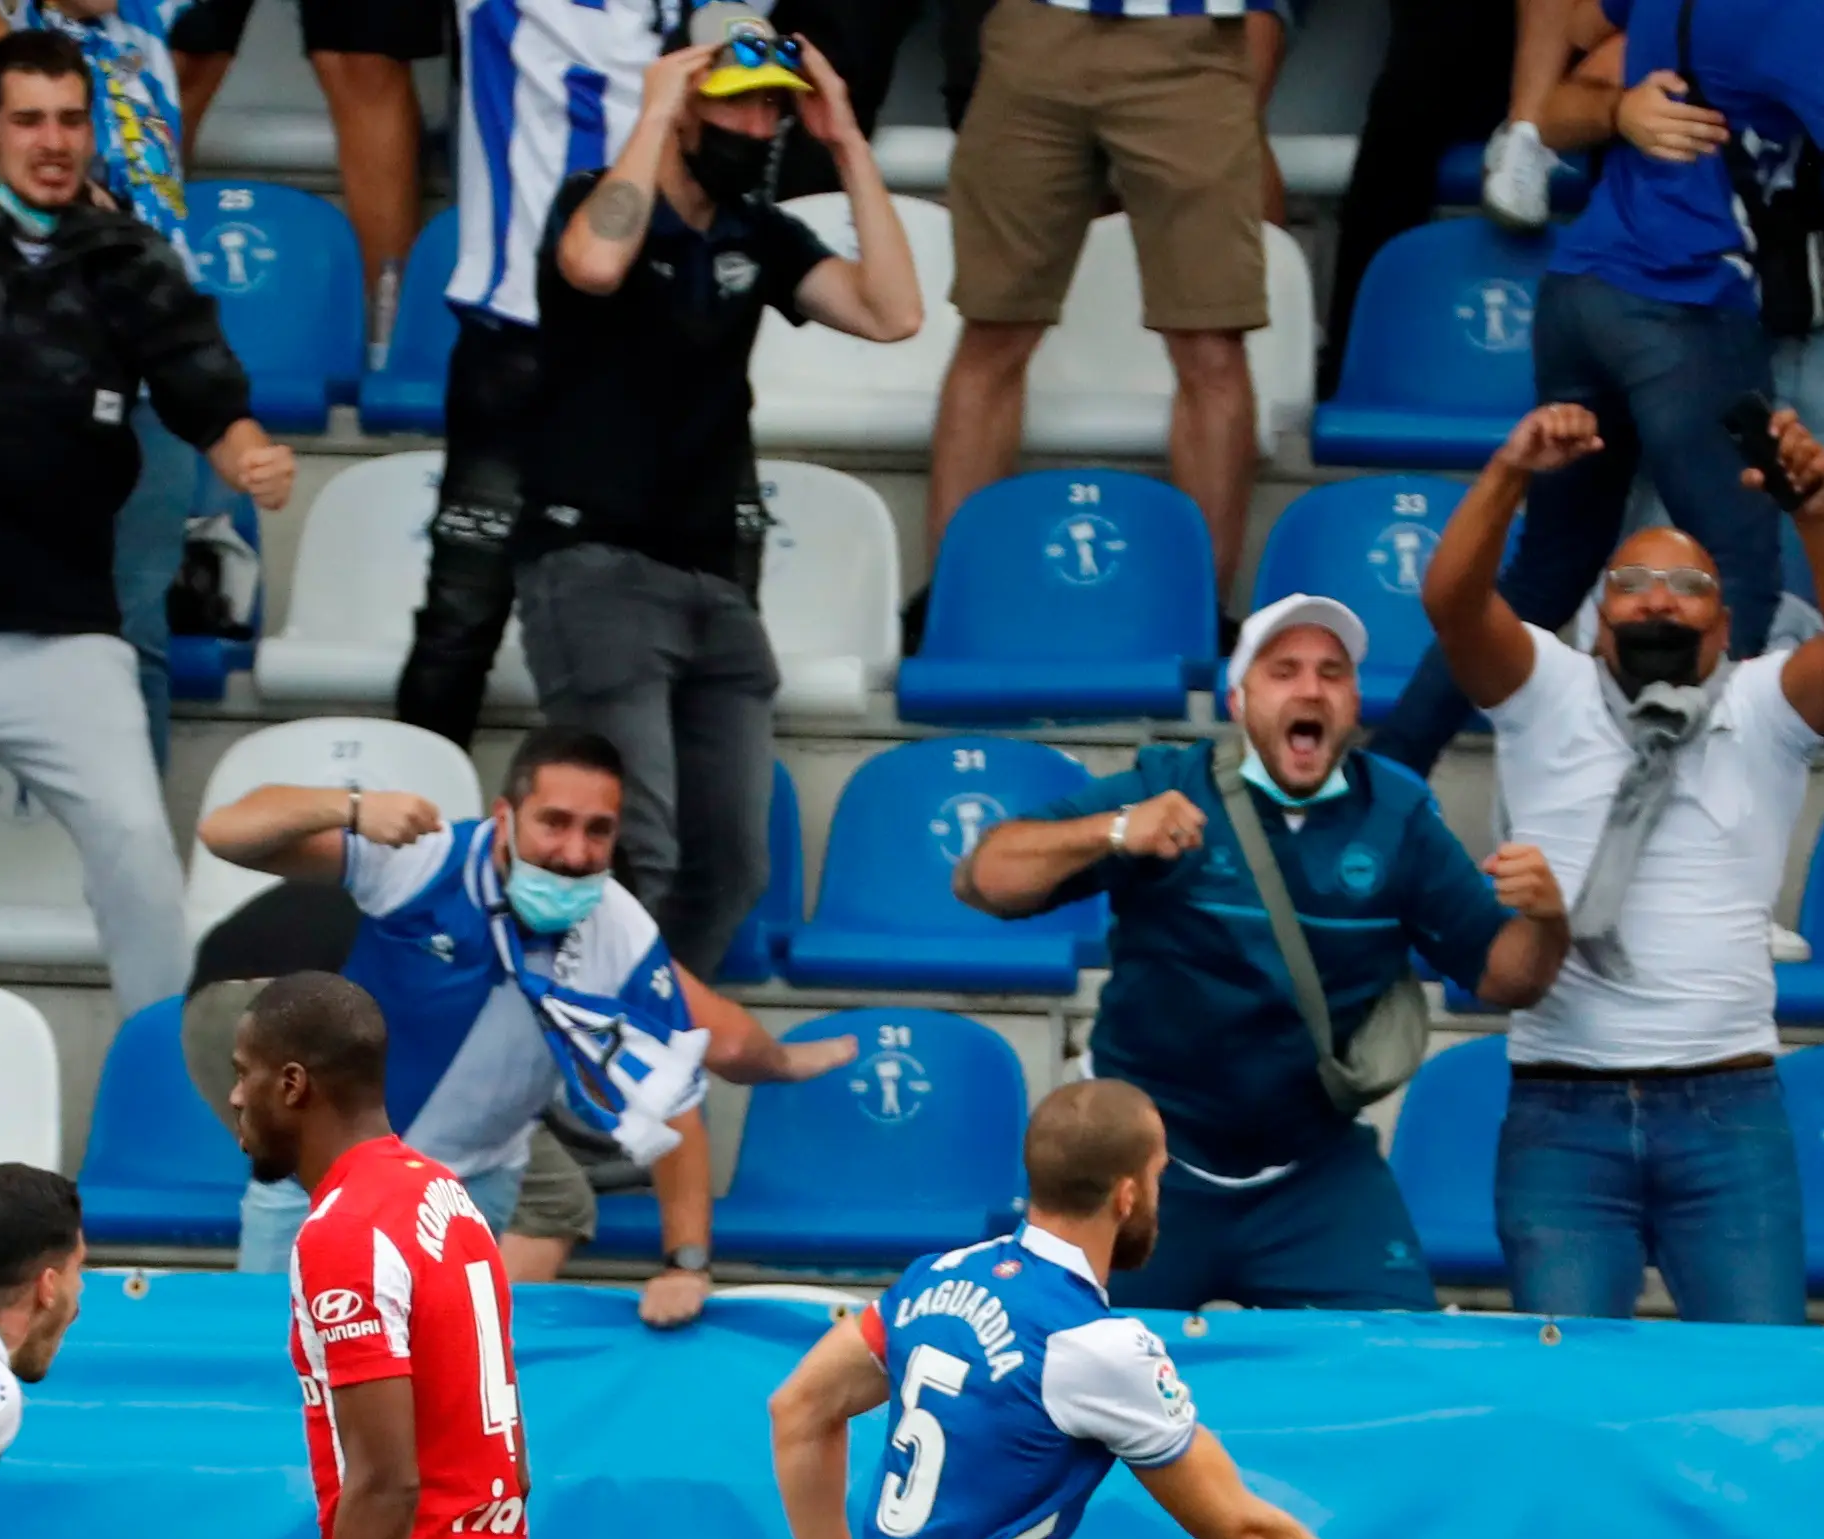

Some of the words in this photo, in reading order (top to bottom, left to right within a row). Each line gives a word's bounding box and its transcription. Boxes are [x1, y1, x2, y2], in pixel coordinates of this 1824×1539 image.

[1068, 483, 1101, 505] 31
[952, 749, 986, 771] 31
[878, 1026, 912, 1048] 31
[894, 1280, 1024, 1383] LAGUARDIA
[877, 1345, 971, 1538] 5
